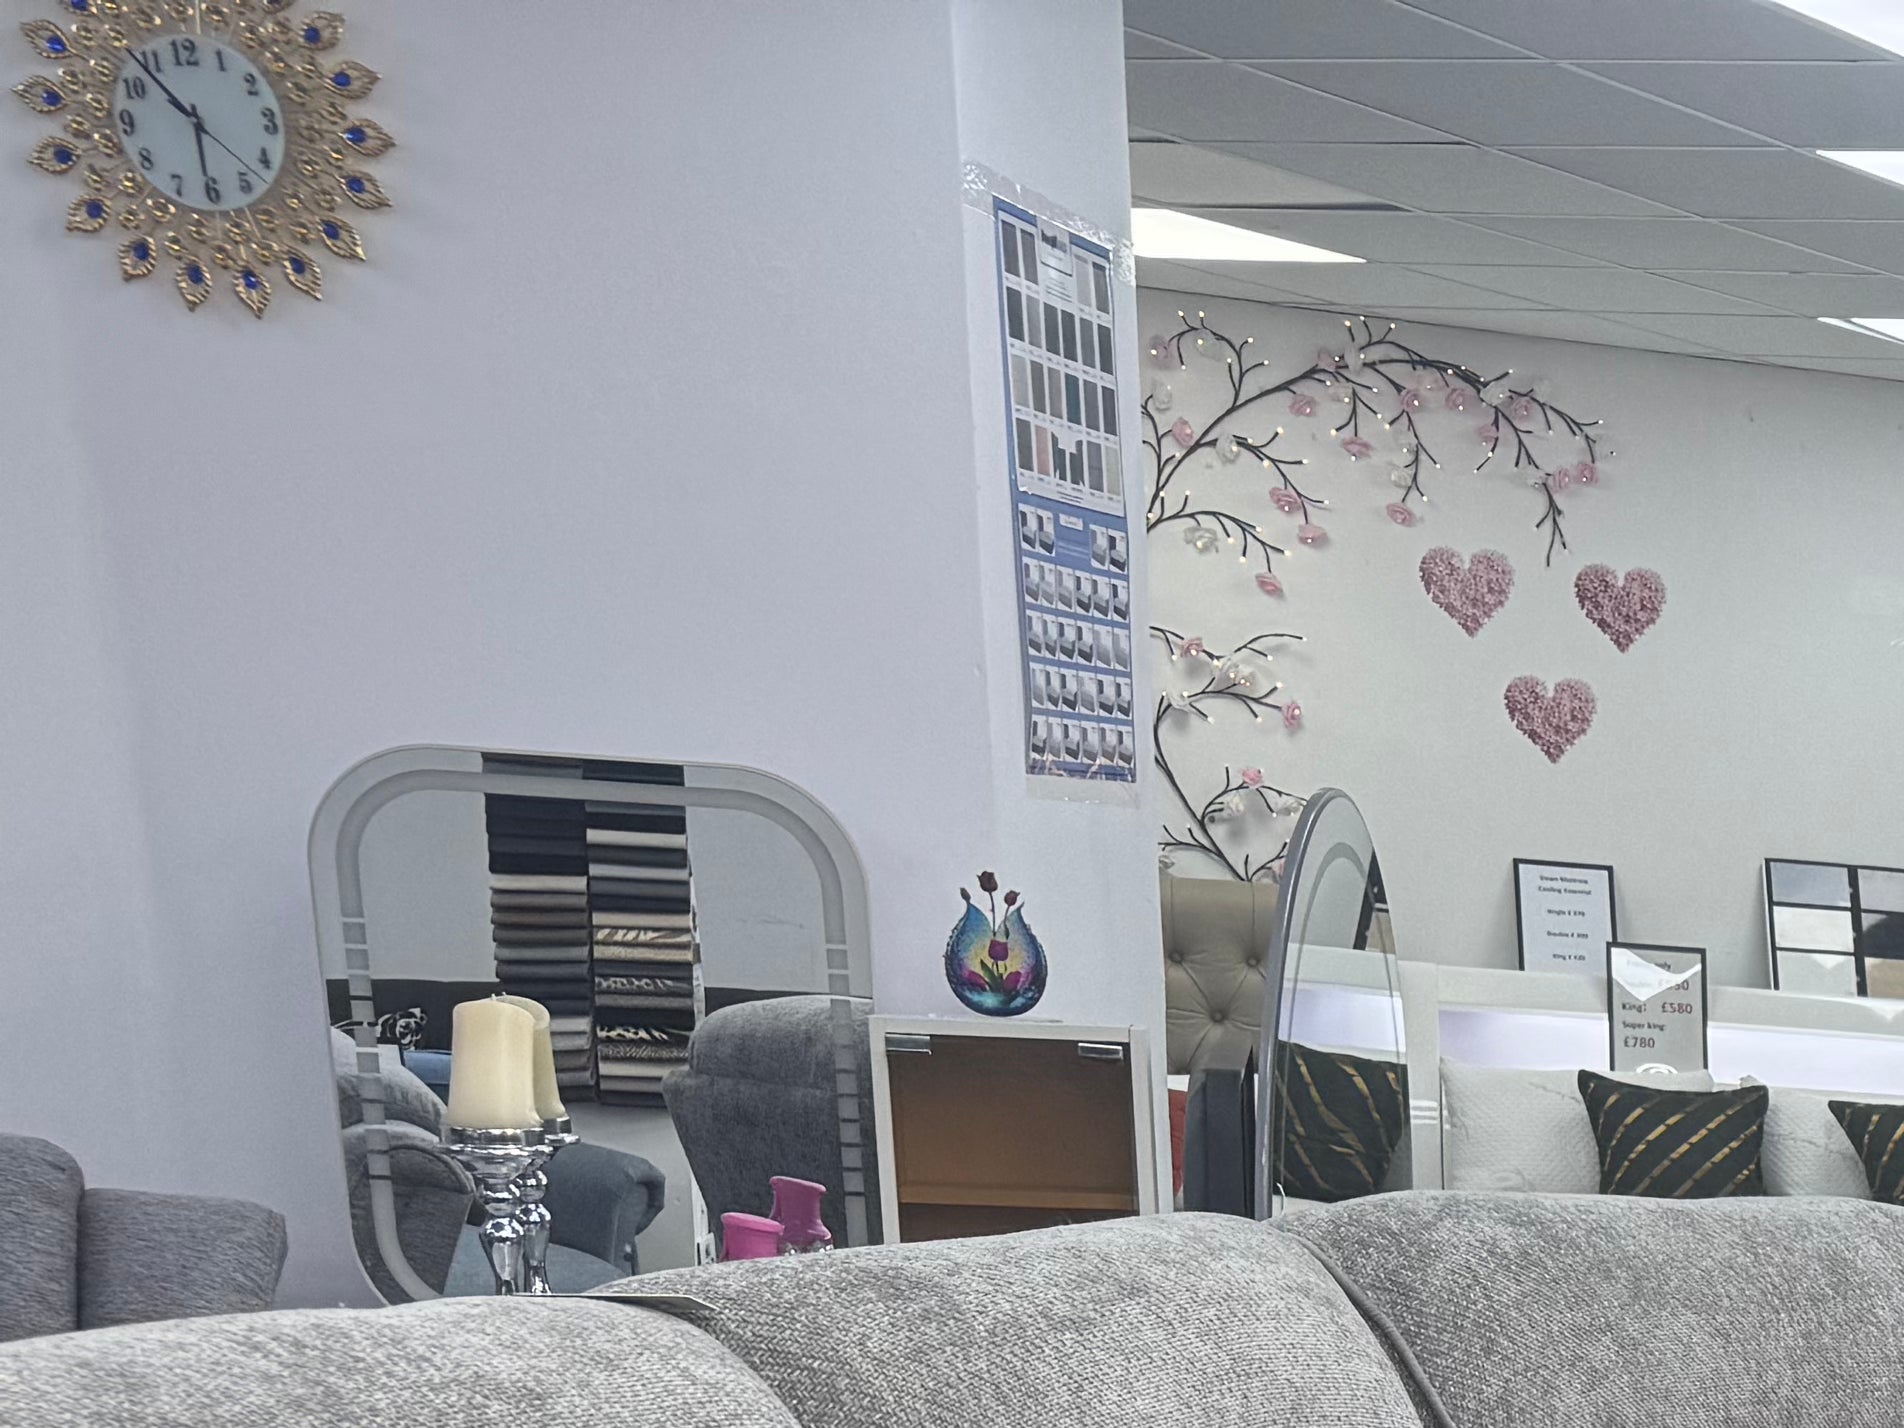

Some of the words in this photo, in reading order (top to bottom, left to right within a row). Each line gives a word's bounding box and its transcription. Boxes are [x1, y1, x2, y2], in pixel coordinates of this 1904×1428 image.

[169, 38, 199, 67] 12
[215, 48, 226, 72] 1
[123, 76, 146, 99] 10
[243, 73, 259, 96] 2
[119, 108, 135, 136] 9
[261, 107, 278, 135] 3
[138, 148, 154, 170] 8
[258, 146, 271, 170] 4
[170, 174, 183, 197] 7
[204, 176, 221, 204] 6
[238, 171, 252, 194] 5
[1661, 1002, 1693, 1014] £580
[1623, 1036, 1655, 1048] £780
